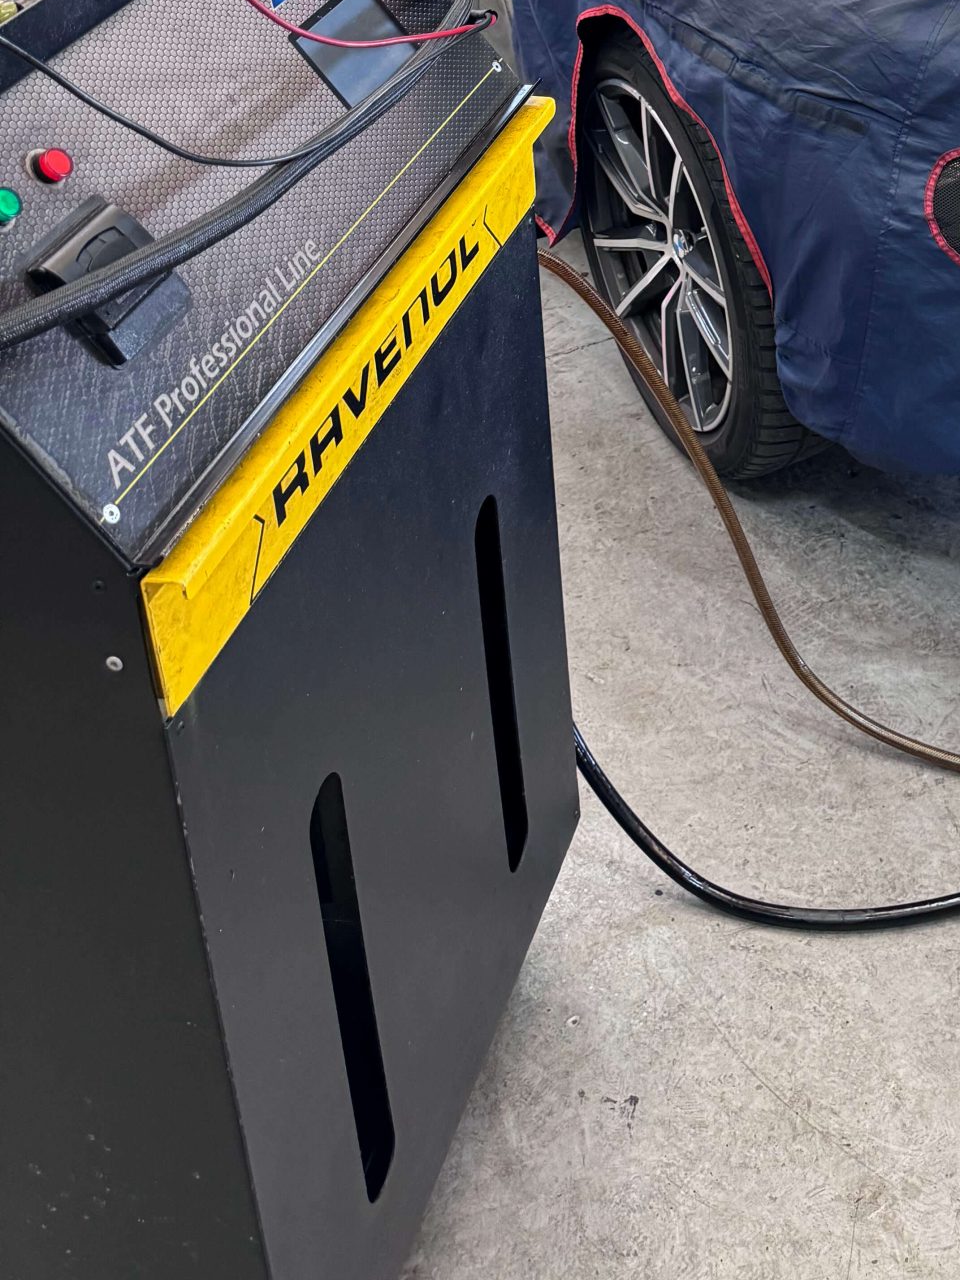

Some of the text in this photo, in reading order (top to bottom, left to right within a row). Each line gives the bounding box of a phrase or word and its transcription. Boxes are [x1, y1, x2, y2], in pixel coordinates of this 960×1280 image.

[107, 238, 321, 490] ATF Professional Line
[272, 234, 480, 528] RAVENOL
